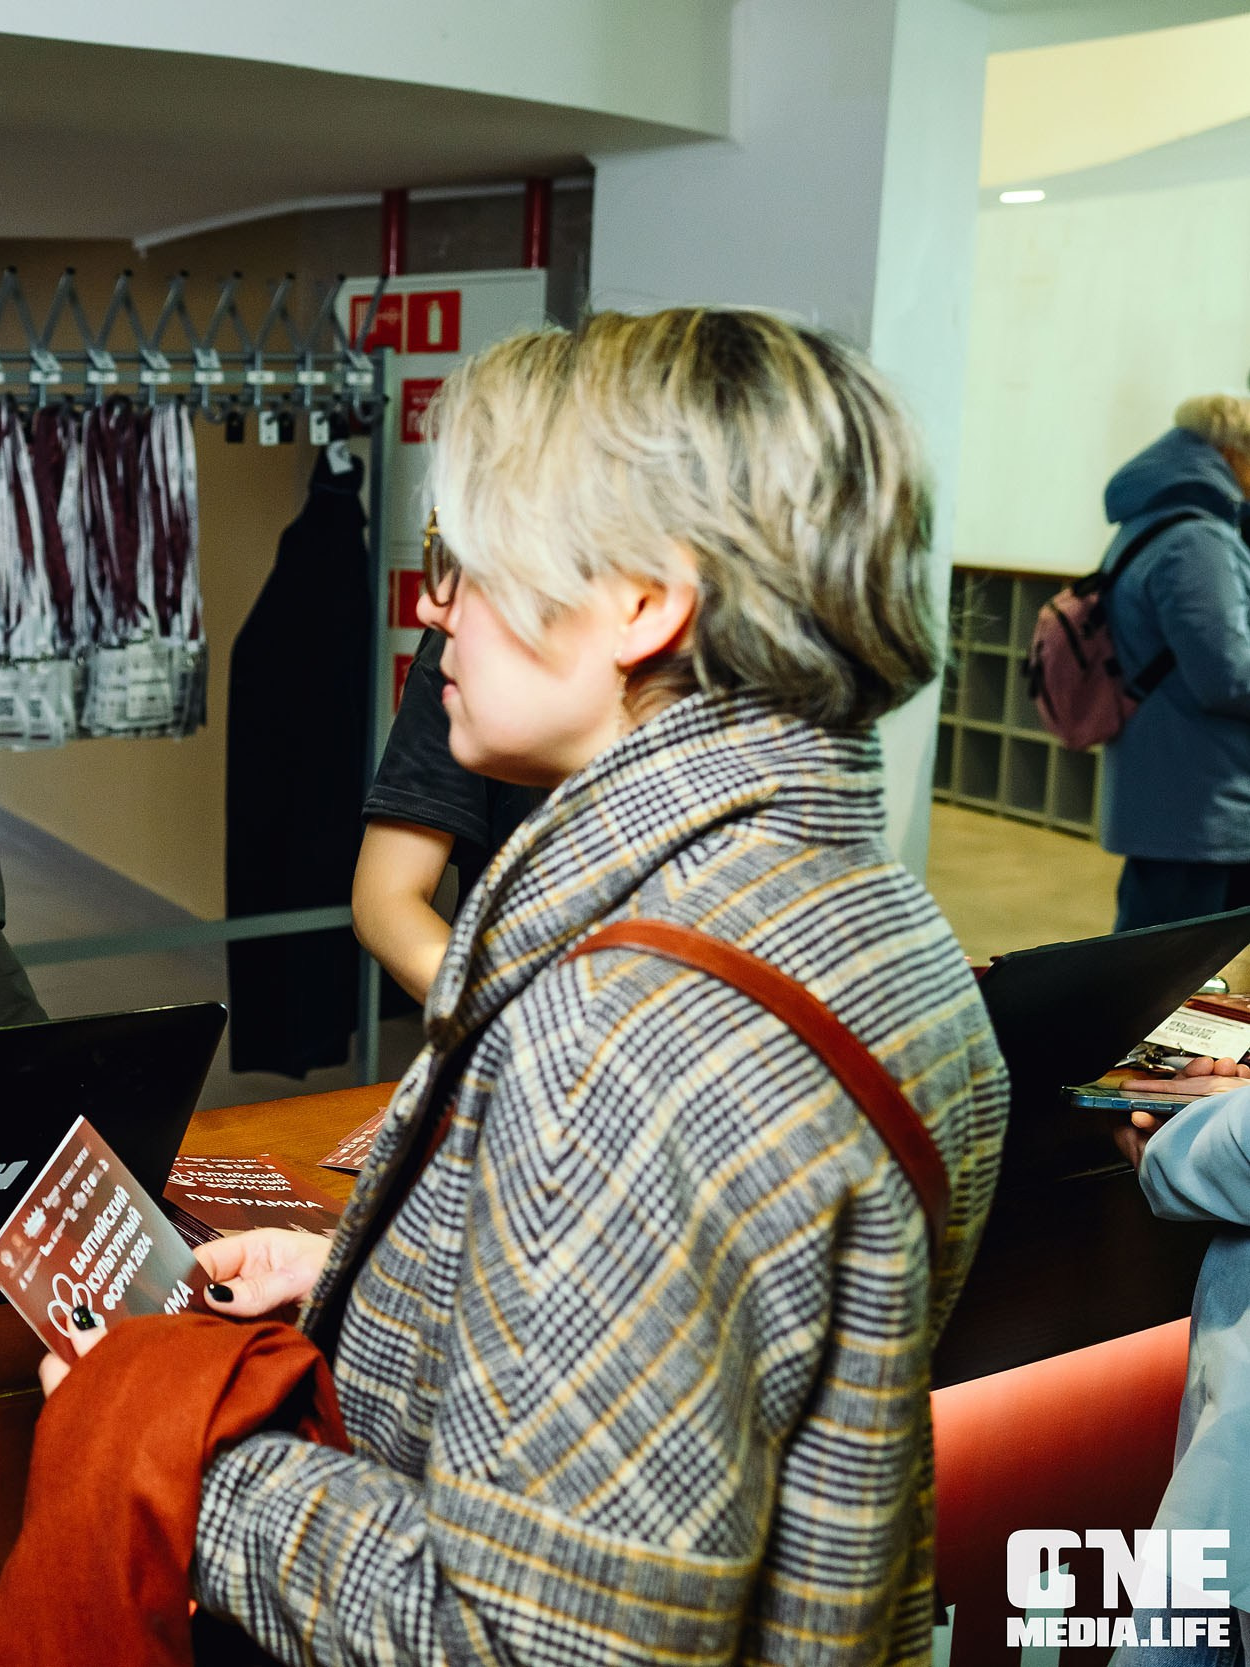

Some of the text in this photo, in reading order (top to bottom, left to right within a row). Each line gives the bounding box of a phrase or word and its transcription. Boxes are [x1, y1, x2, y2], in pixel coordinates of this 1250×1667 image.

[69, 1183, 131, 1276] БАЛТИЙСКИЙ
[184, 1193, 325, 1208] ПРОГРАММА
[85, 1204, 143, 1295] КУЛЬТУРНЫЙ
[102, 1232, 154, 1311] ФОРУМ 2024
